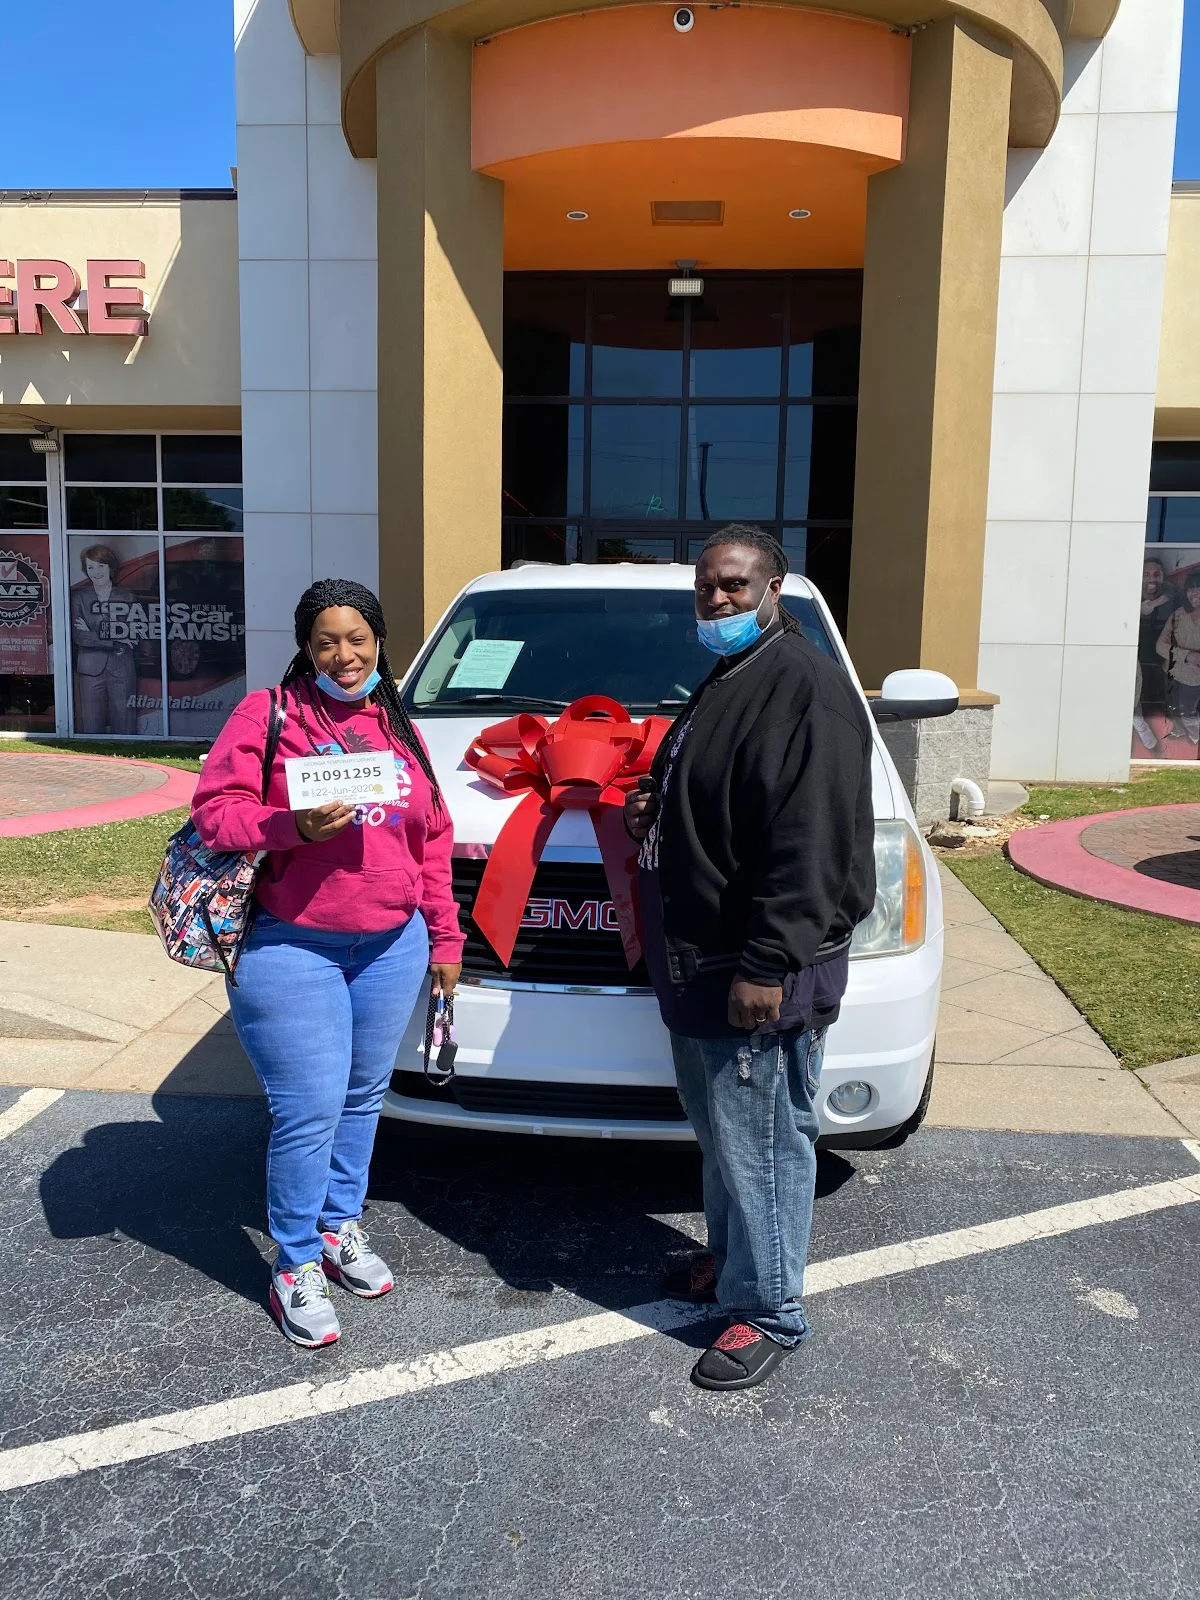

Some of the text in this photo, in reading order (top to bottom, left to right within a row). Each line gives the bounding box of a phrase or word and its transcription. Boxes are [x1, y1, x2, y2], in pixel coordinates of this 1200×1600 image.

[191, 611, 234, 623] car
[301, 766, 382, 783] P1091295
[315, 783, 374, 797] 22-Jun-2020
